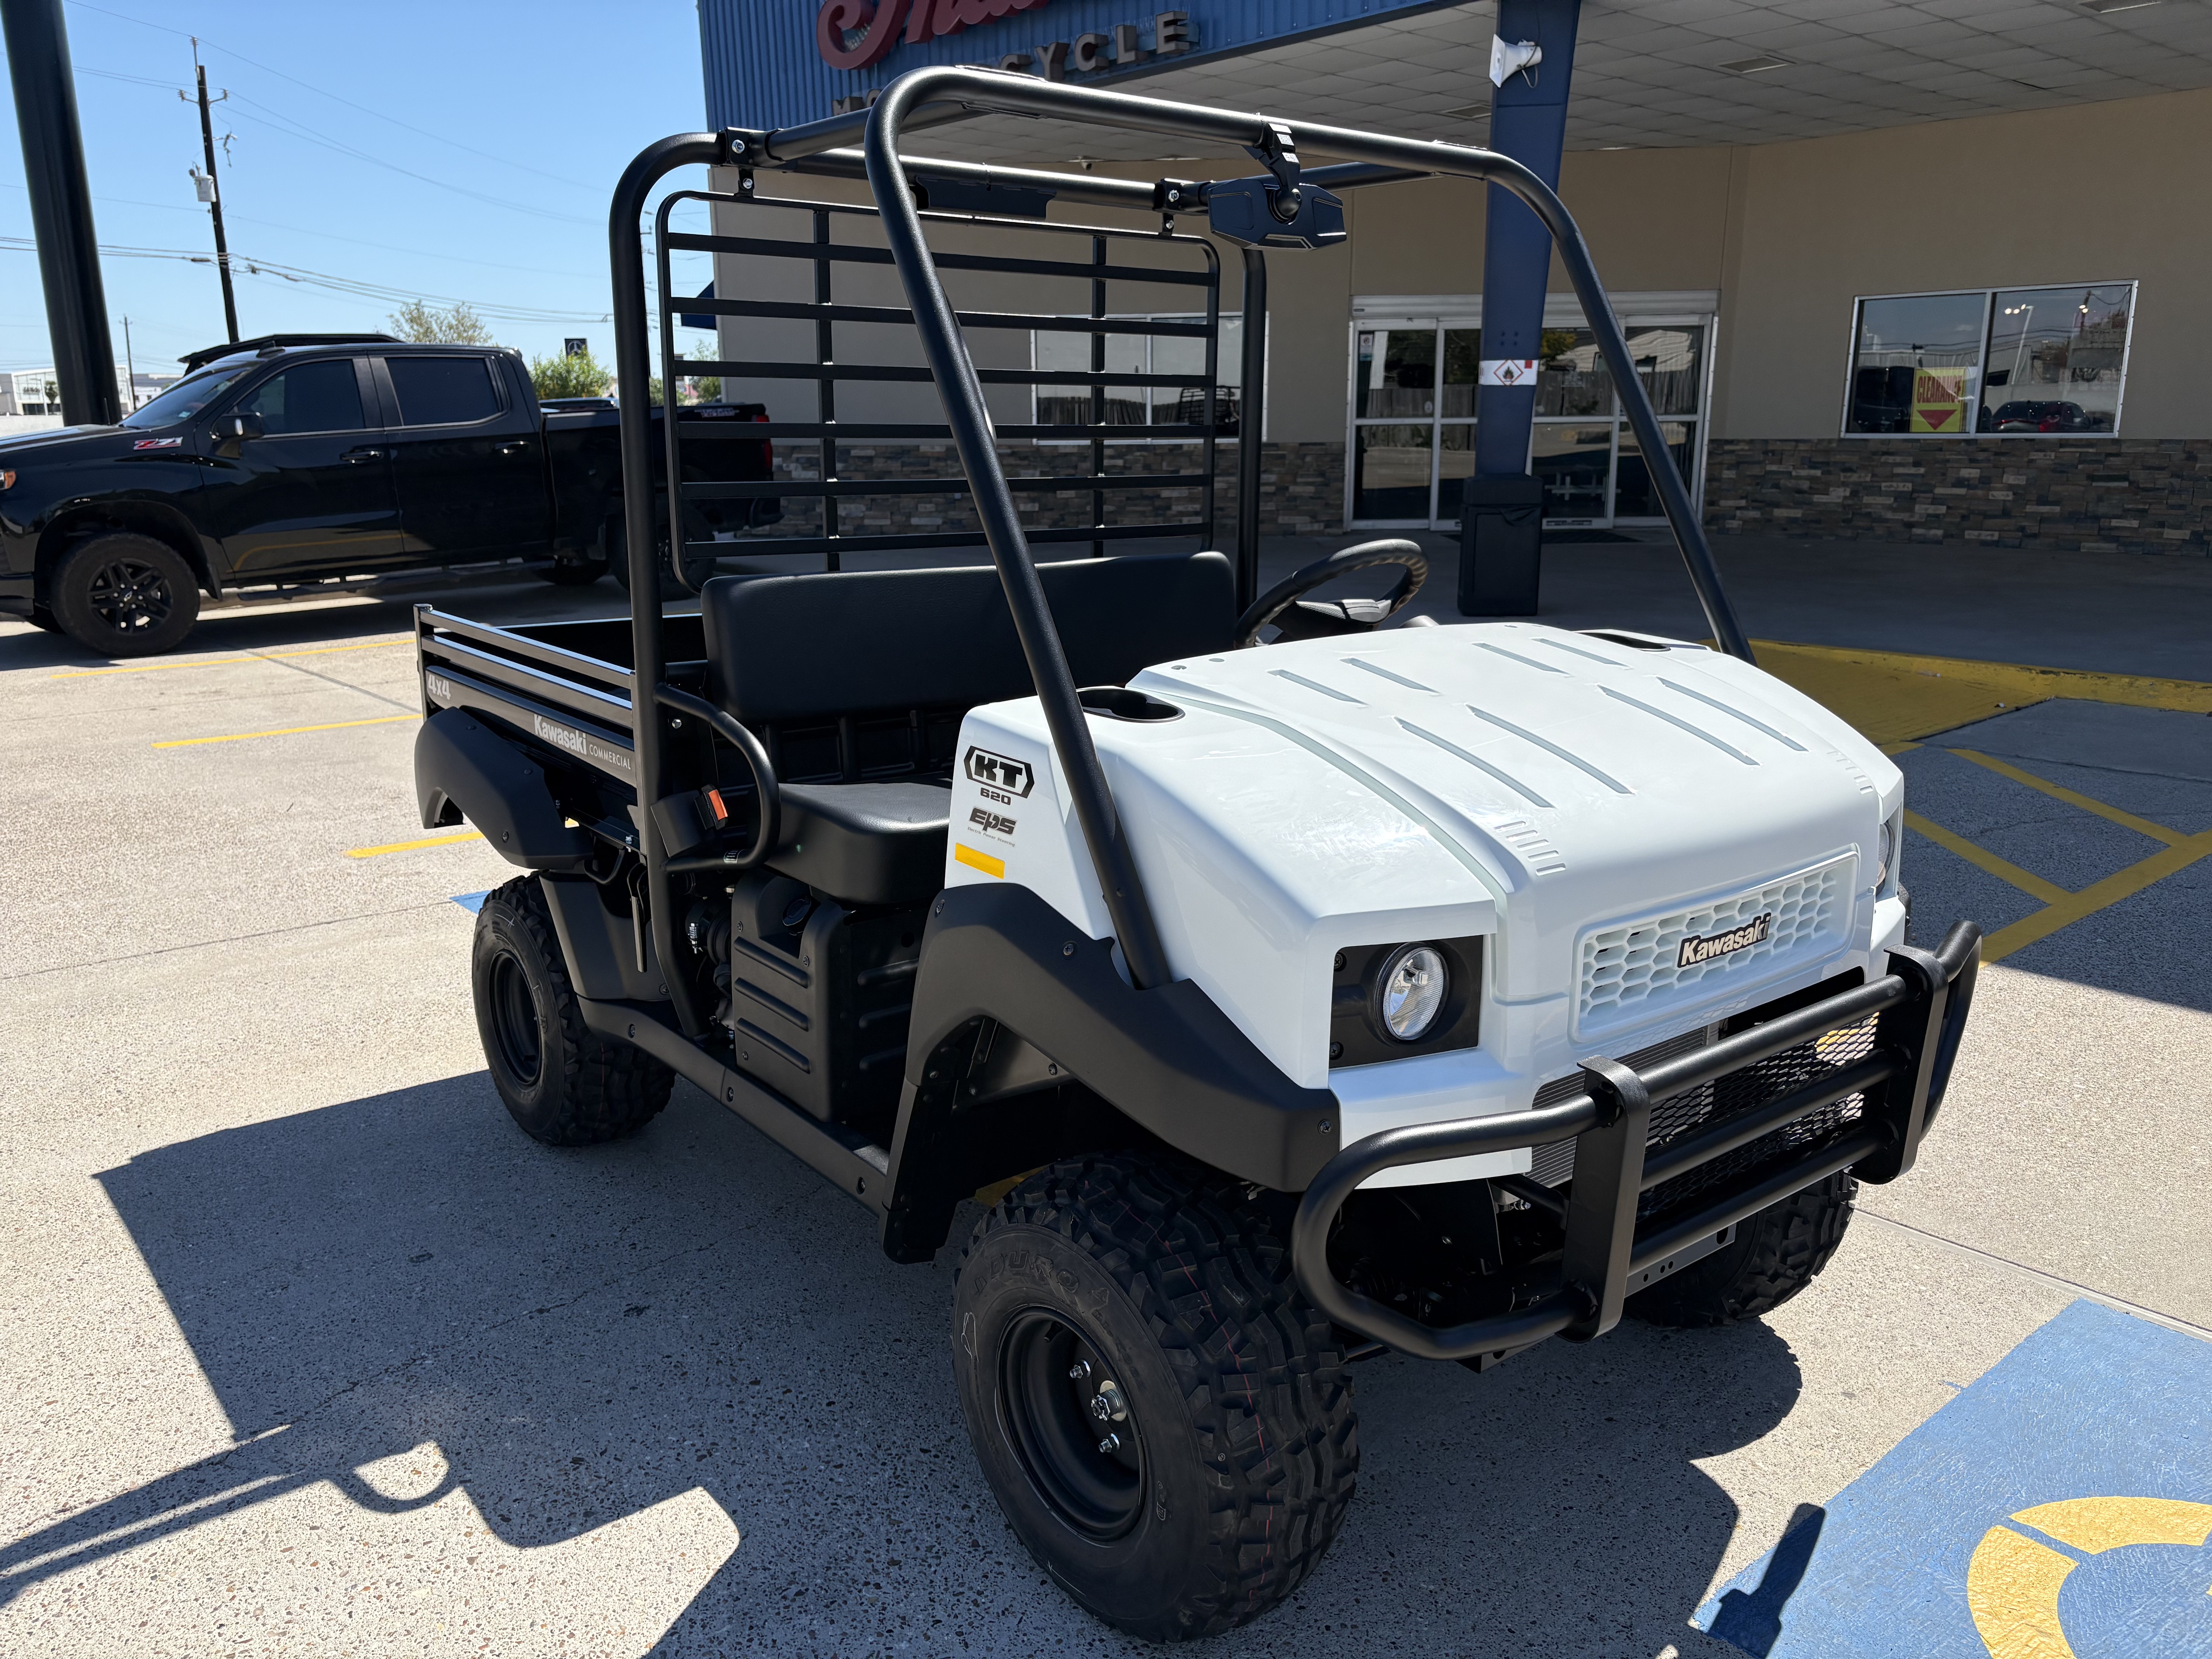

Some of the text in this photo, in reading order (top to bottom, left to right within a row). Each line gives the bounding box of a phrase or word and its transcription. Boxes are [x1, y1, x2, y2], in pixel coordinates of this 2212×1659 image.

[1917, 376, 1963, 403] CLEARANCE
[134, 437, 183, 450] Z71
[534, 714, 631, 770] Kawasaki COMMERCIAL
[974, 753, 1023, 788] KT
[980, 787, 1011, 805] 620
[967, 826, 982, 835] Electric
[997, 837, 1016, 847] Steering
[1680, 915, 1771, 967] Kawasaki
[990, 1249, 1080, 1294] DURO
